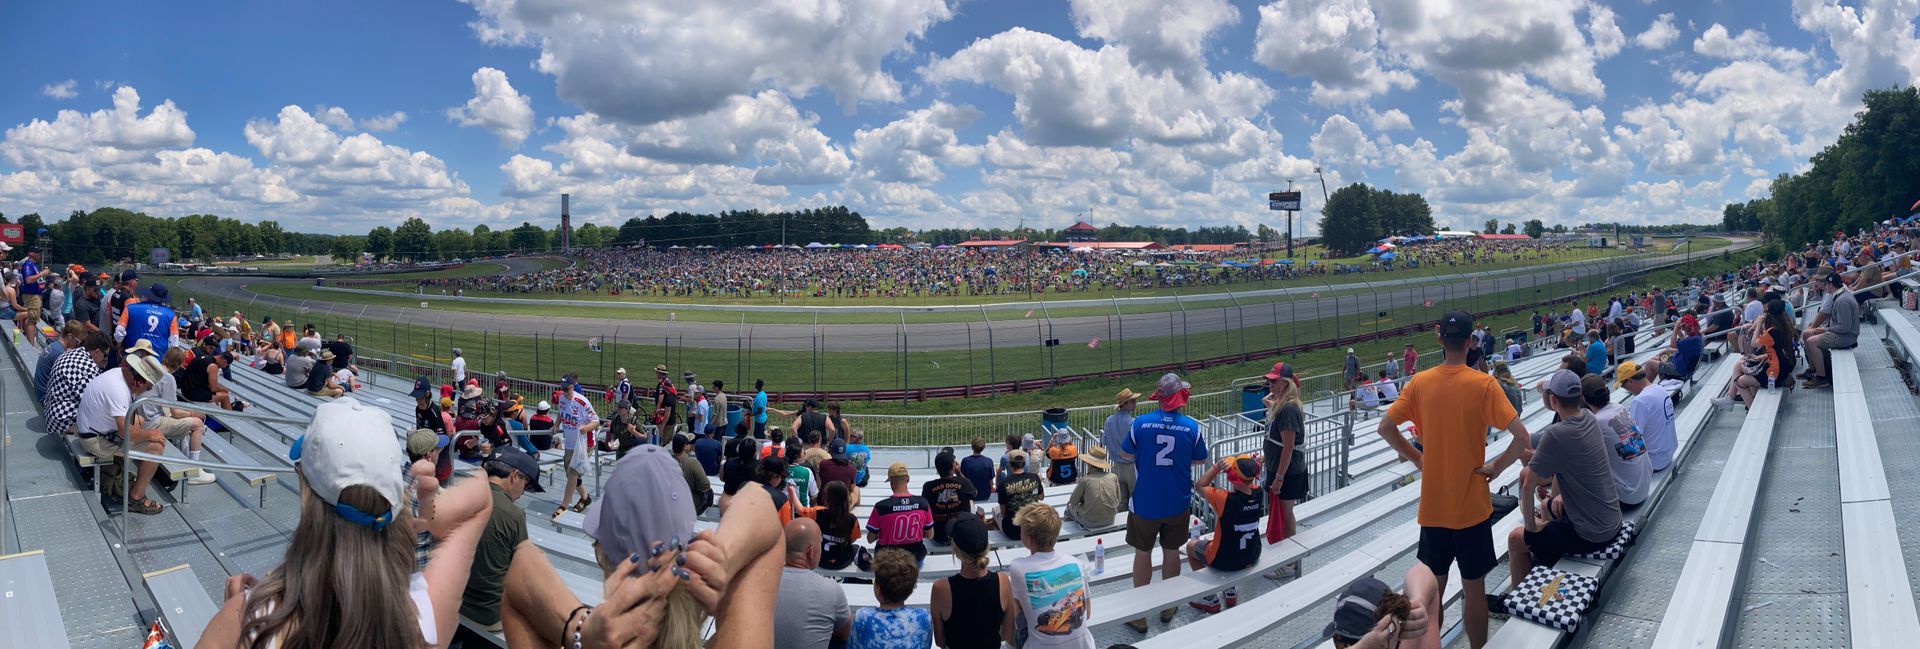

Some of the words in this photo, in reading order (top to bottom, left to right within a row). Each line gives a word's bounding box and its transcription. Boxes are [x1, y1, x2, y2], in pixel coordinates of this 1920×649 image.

[148, 315, 158, 332] 9
[1142, 423, 1190, 432] NEWGARDEN
[1156, 434, 1175, 466] 2
[1060, 464, 1071, 478] 5
[893, 513, 920, 542] 06
